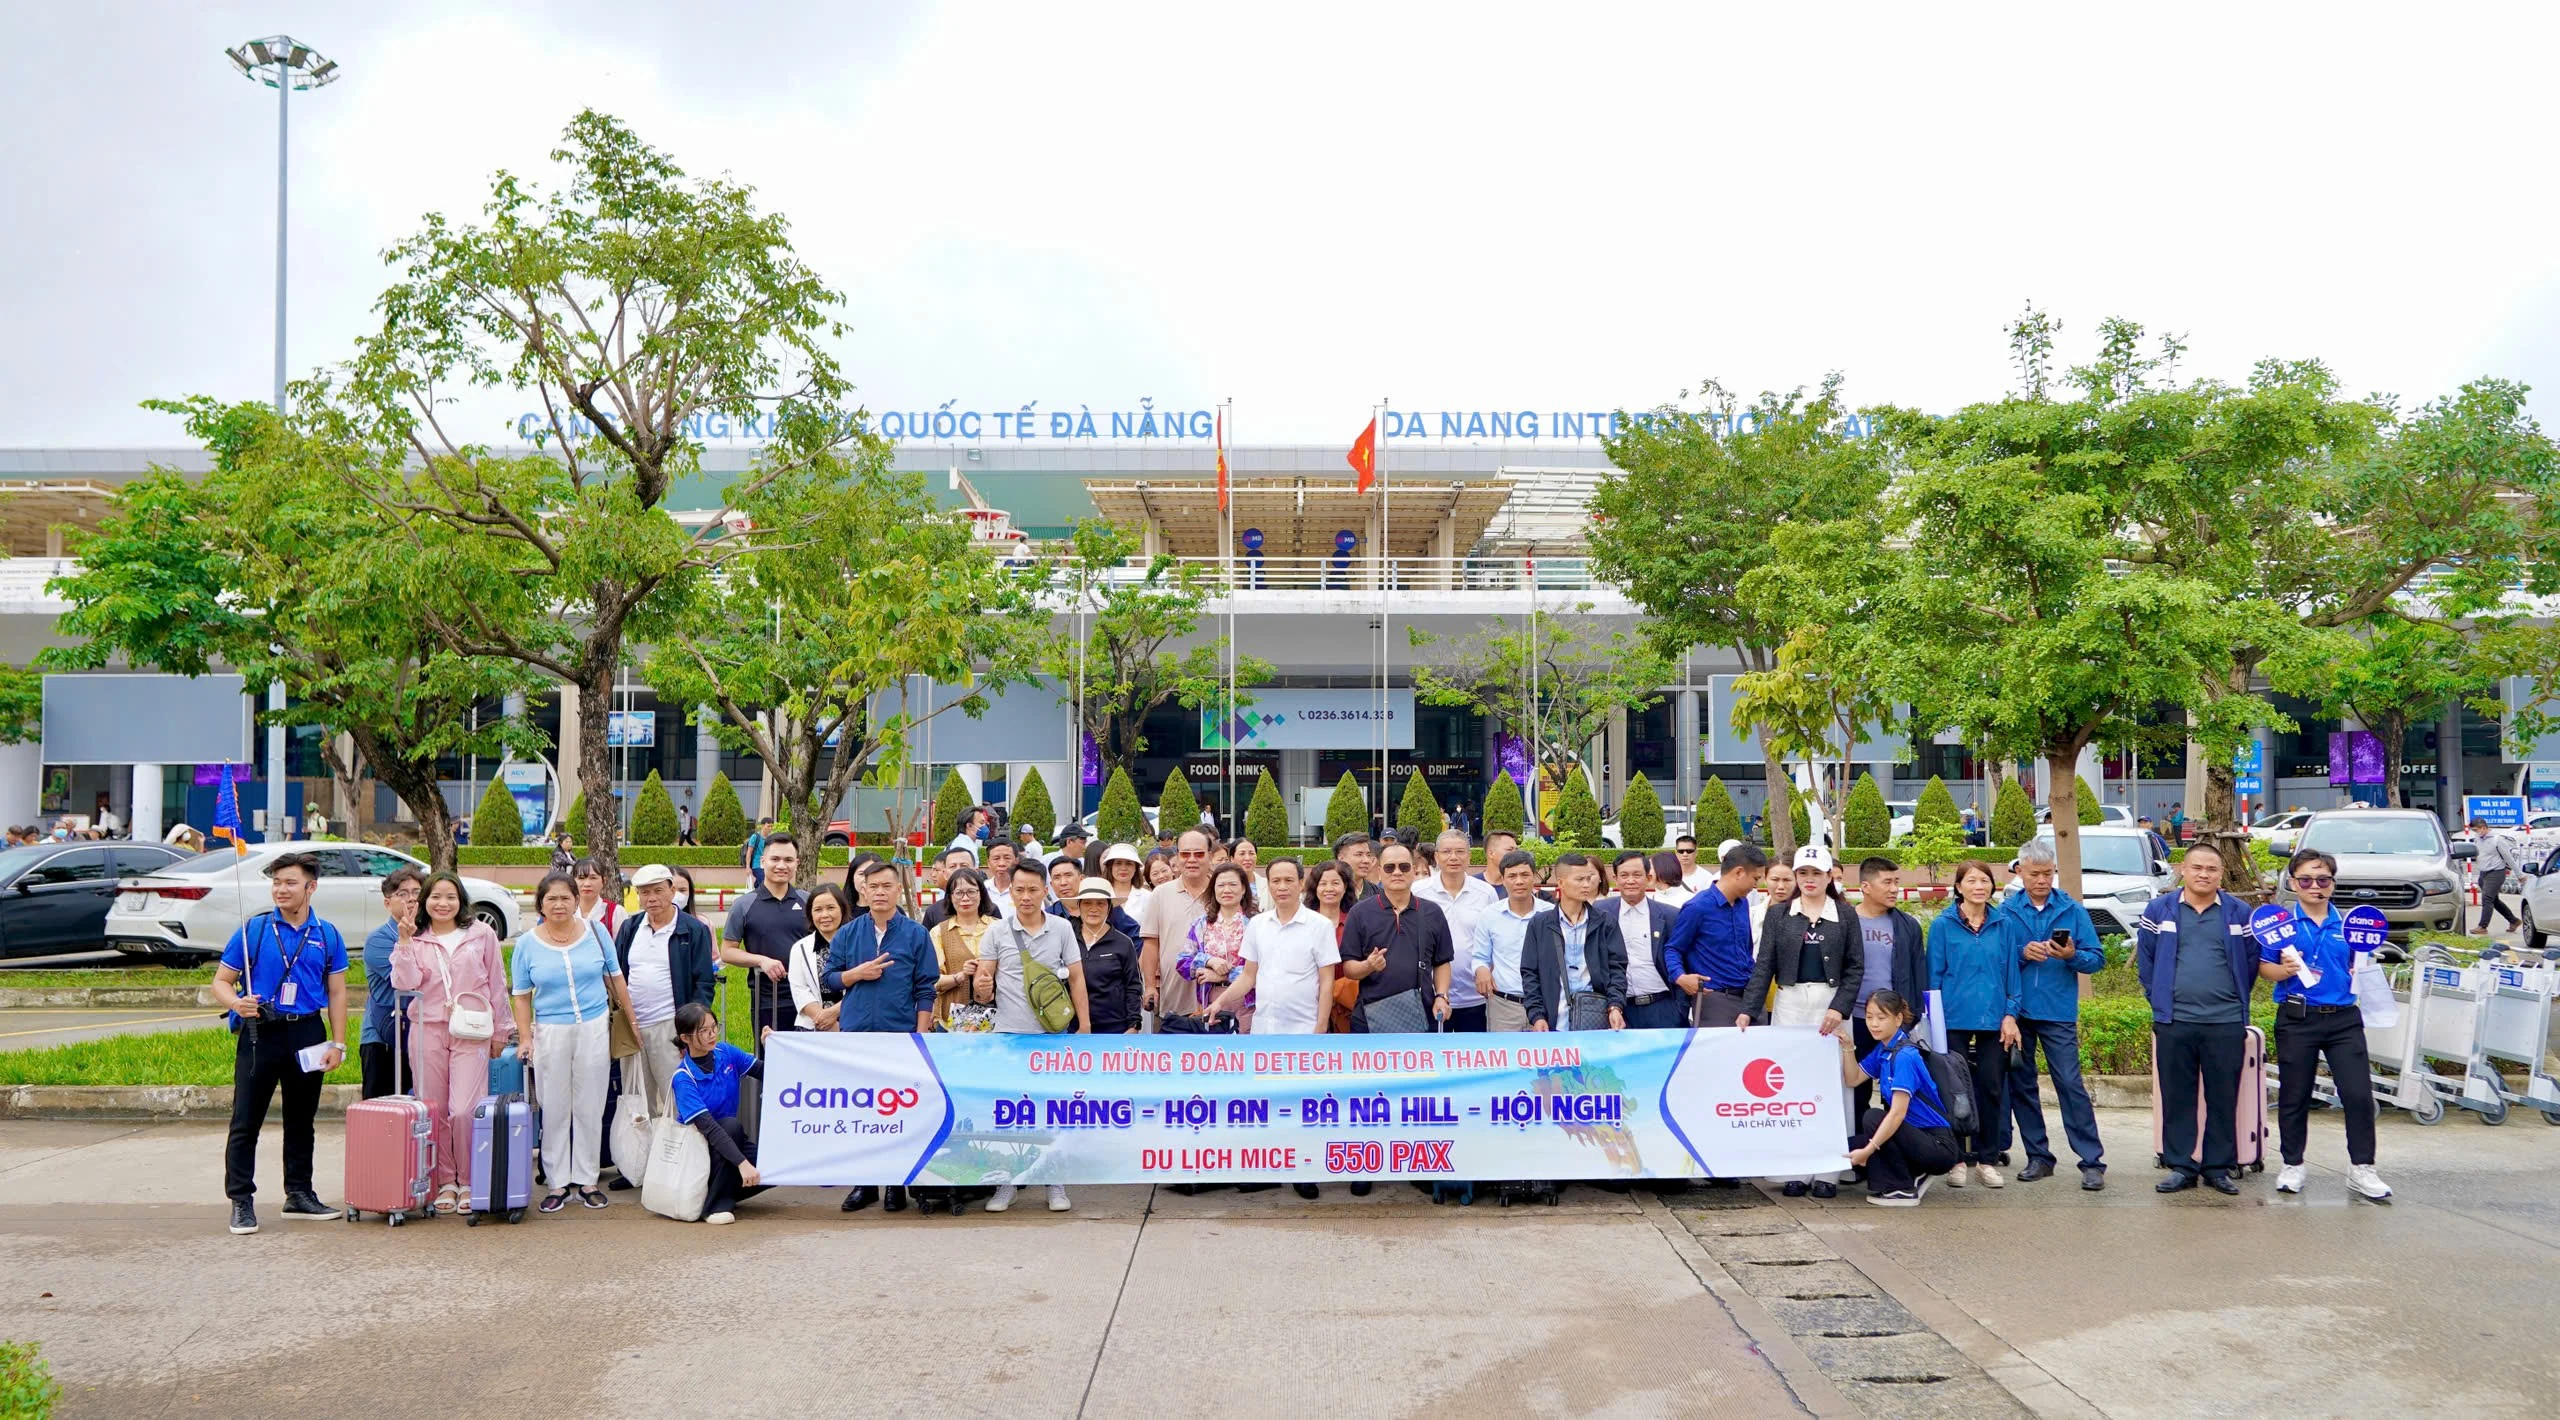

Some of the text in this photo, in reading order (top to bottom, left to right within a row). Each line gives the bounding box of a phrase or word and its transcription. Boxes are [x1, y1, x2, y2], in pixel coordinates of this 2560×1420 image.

[881, 398, 981, 439] QUỐC
[993, 400, 1038, 438] TẾ
[1051, 404, 1098, 438] ĐÀ
[1112, 397, 1213, 438] NẴNG
[1383, 411, 1427, 438] DA
[1441, 410, 1539, 438] NANG
[1308, 710, 1394, 720] 0236.3614.338
[1190, 764, 1219, 776] FOOD
[1228, 764, 1266, 776] RINKS
[2263, 924, 2296, 945] XE 02
[2348, 931, 2365, 943] XE
[2366, 933, 2381, 944] 03
[1029, 1047, 1582, 1073] CHÀO MỪNG ĐOÀN DETECH MOTOR THAM QUAN
[779, 1082, 919, 1116] danago
[993, 1094, 1036, 1127] ĐÀ
[1046, 1090, 1133, 1127] NẴNG
[1165, 1094, 1217, 1132] HỘI
[1227, 1099, 1269, 1126] AN
[1302, 1093, 1340, 1124] BÀ
[1349, 1092, 1390, 1124] NÀ
[1400, 1096, 1459, 1123] HILL
[1490, 1090, 1542, 1130] HỘI
[1552, 1094, 1623, 1129] NGHỊ
[791, 1120, 904, 1134] Tour & Travel
[1142, 1149, 1173, 1170] DU
[1182, 1148, 1232, 1174] LỊCH
[1241, 1148, 1296, 1169] MICE
[1326, 1141, 1384, 1173] 550
[1390, 1141, 1455, 1173] PAX
